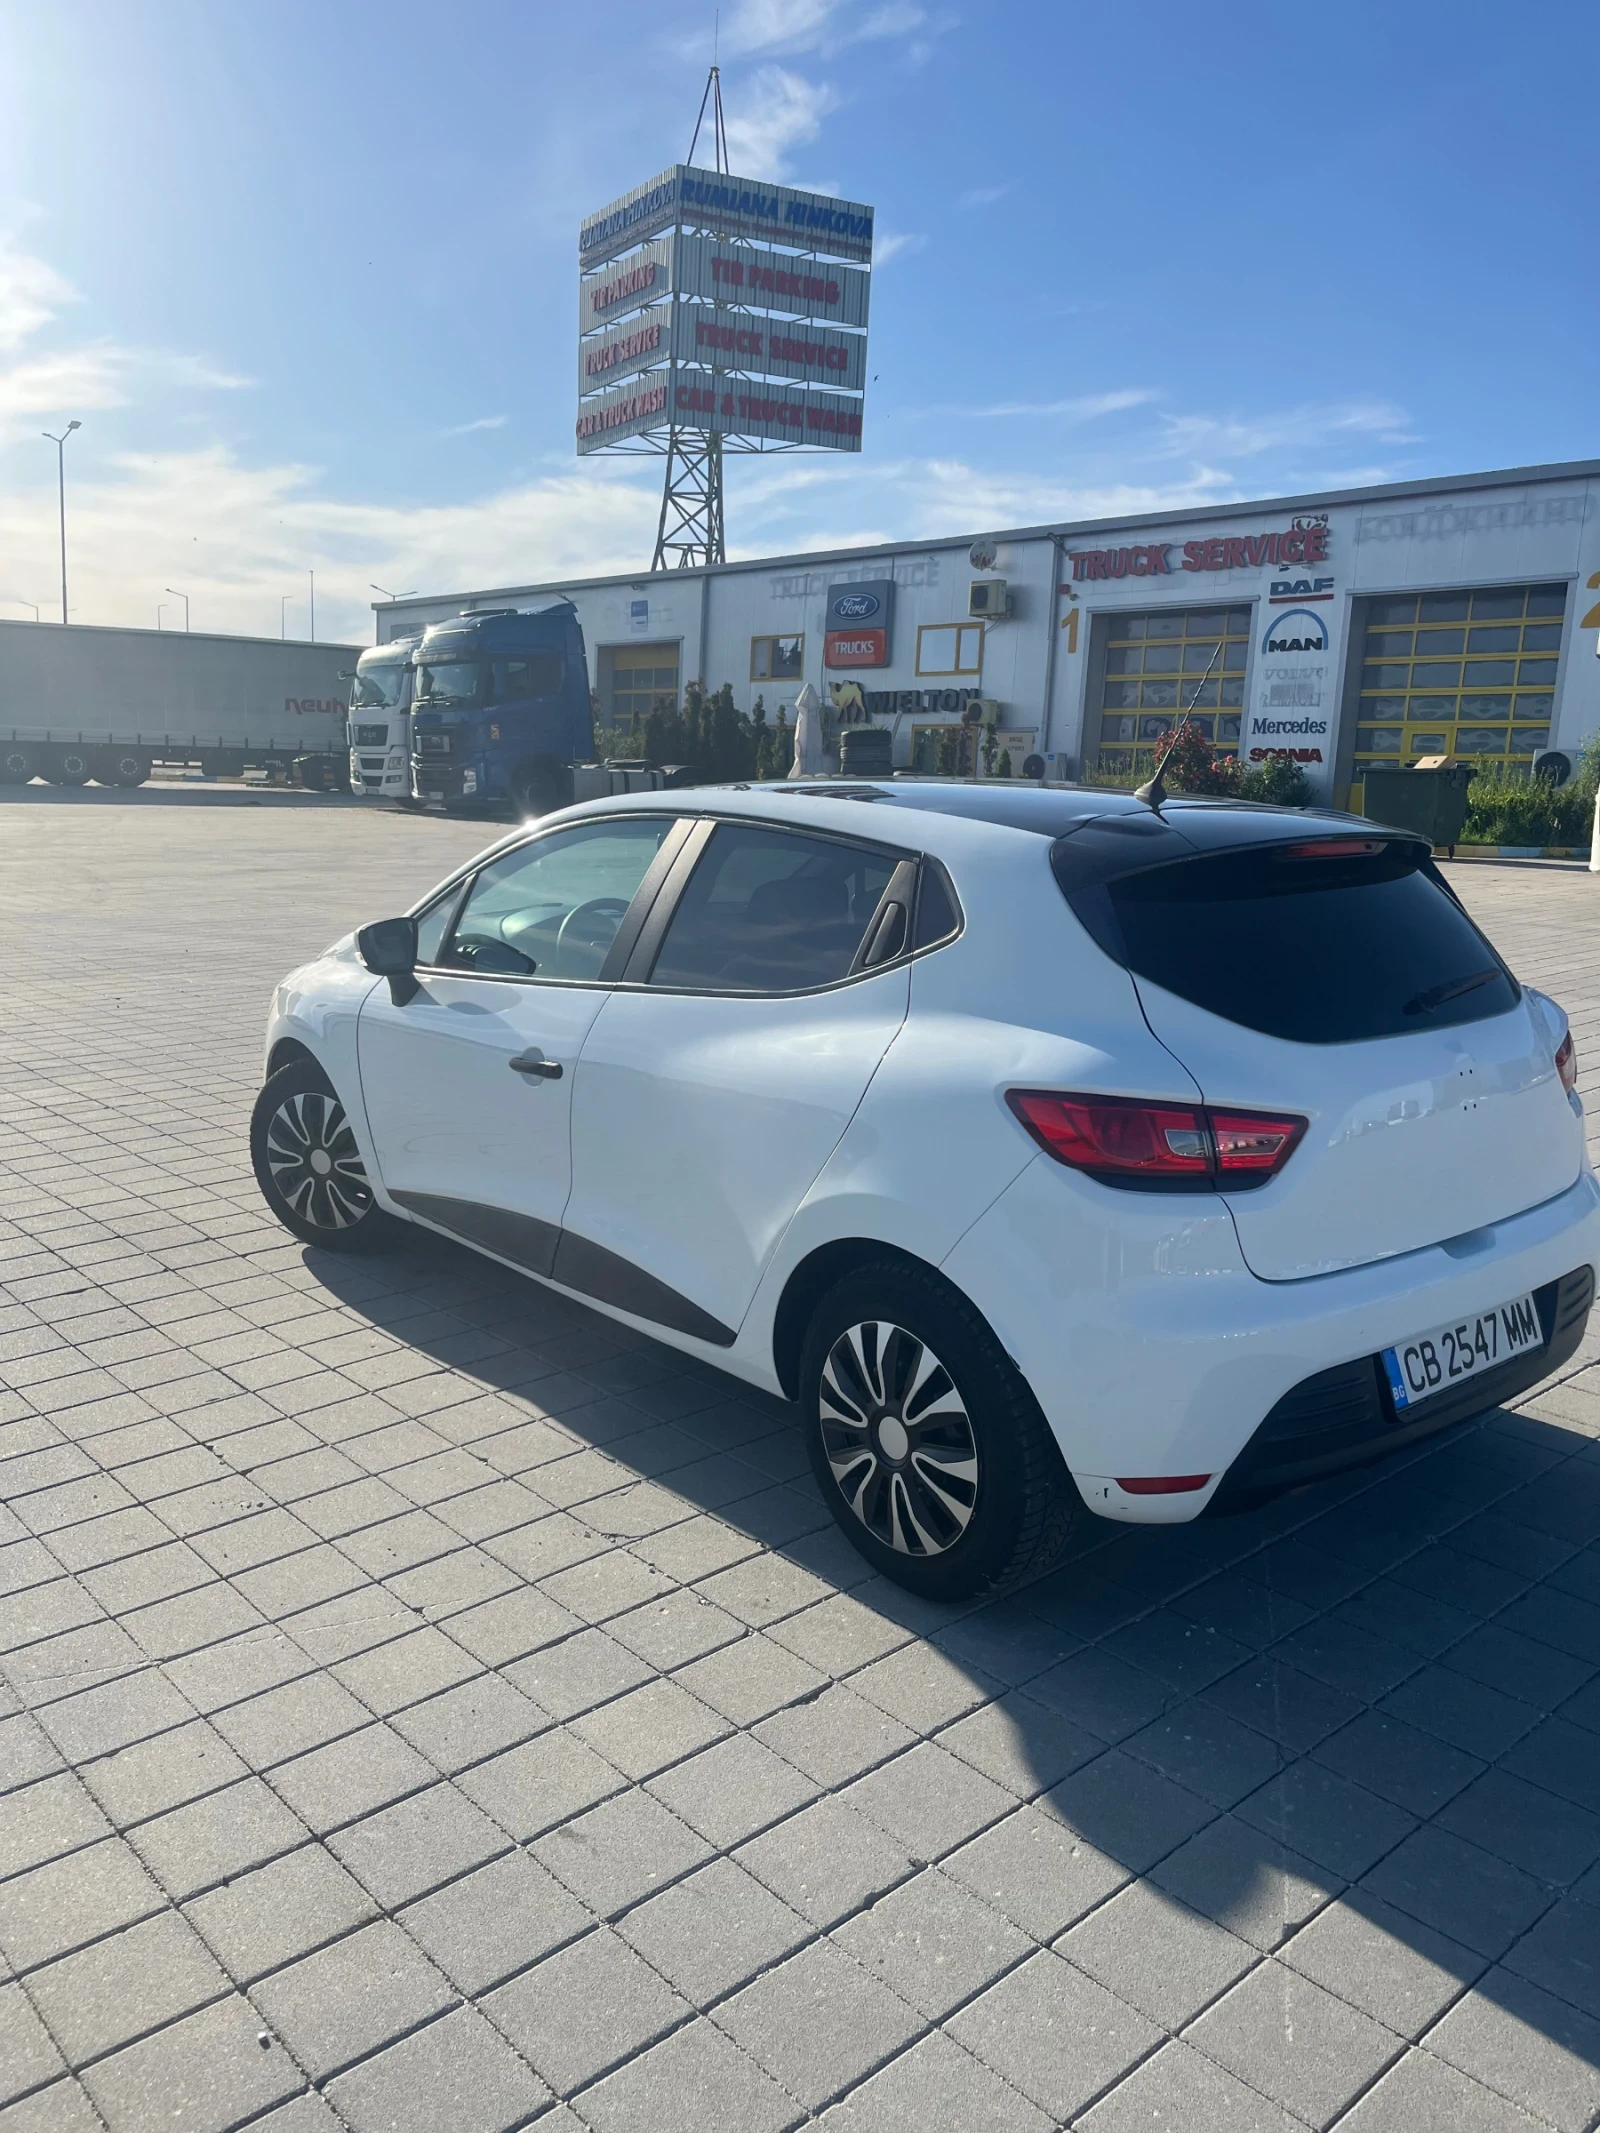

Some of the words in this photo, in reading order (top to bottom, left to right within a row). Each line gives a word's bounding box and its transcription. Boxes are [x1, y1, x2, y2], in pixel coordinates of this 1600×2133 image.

[580, 207, 626, 252] RUMIANA
[627, 178, 675, 226] HINKOVA
[680, 177, 779, 220] RUMIANA
[784, 200, 873, 240] HINKOVA
[608, 262, 655, 304] PARKING
[711, 257, 744, 286] TIR
[748, 265, 840, 304] PARKING
[586, 346, 616, 376] TRUCK
[618, 324, 661, 362] SERVICE
[696, 322, 763, 356] TRUCK
[769, 335, 849, 371] SERVICE
[576, 416, 593, 440] CAR
[602, 397, 635, 427] TRUCK
[635, 386, 667, 418] WASH
[674, 385, 717, 413] CAR
[721, 392, 735, 417] &
[739, 395, 804, 428] TRUCK
[806, 406, 862, 437] WASH
[1069, 543, 1172, 582] TRUCK
[1181, 526, 1328, 572] SERVICE
[840, 597, 869, 615] Ford
[1270, 577, 1335, 597] DAF
[834, 640, 875, 655] TRUCKS
[1061, 608, 1080, 654] 1
[1268, 637, 1323, 653] MAN
[866, 688, 980, 714] WIELTON
[1251, 717, 1327, 735] Mercedes
[1248, 747, 1323, 763] SCANIA
[1403, 1340, 1442, 1393] CB
[1442, 1312, 1497, 1378] 2547
[1501, 1298, 1539, 1351] MM
[1392, 1384, 1406, 1401] BG
